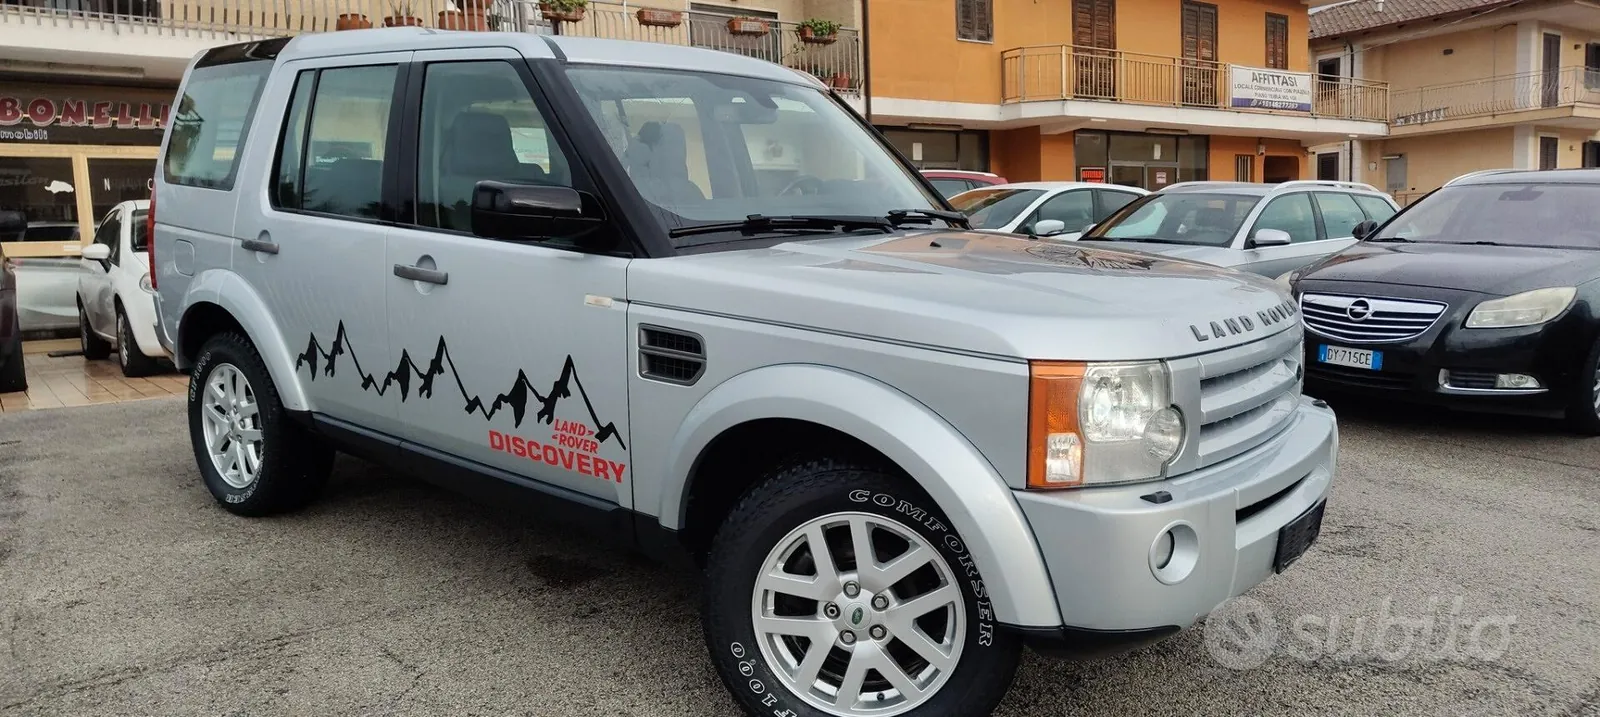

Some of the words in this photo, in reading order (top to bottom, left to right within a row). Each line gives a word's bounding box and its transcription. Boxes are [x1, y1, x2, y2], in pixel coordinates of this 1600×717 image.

[1251, 72, 1298, 87] AFFITTASI
[0, 129, 48, 140] mobili
[1189, 315, 1255, 342] LAND
[1256, 299, 1297, 326] ROVER
[554, 418, 586, 437] LAND
[558, 434, 599, 454] ROVER
[488, 429, 626, 483] DISCOVERY
[849, 489, 994, 647] COMFORSER
